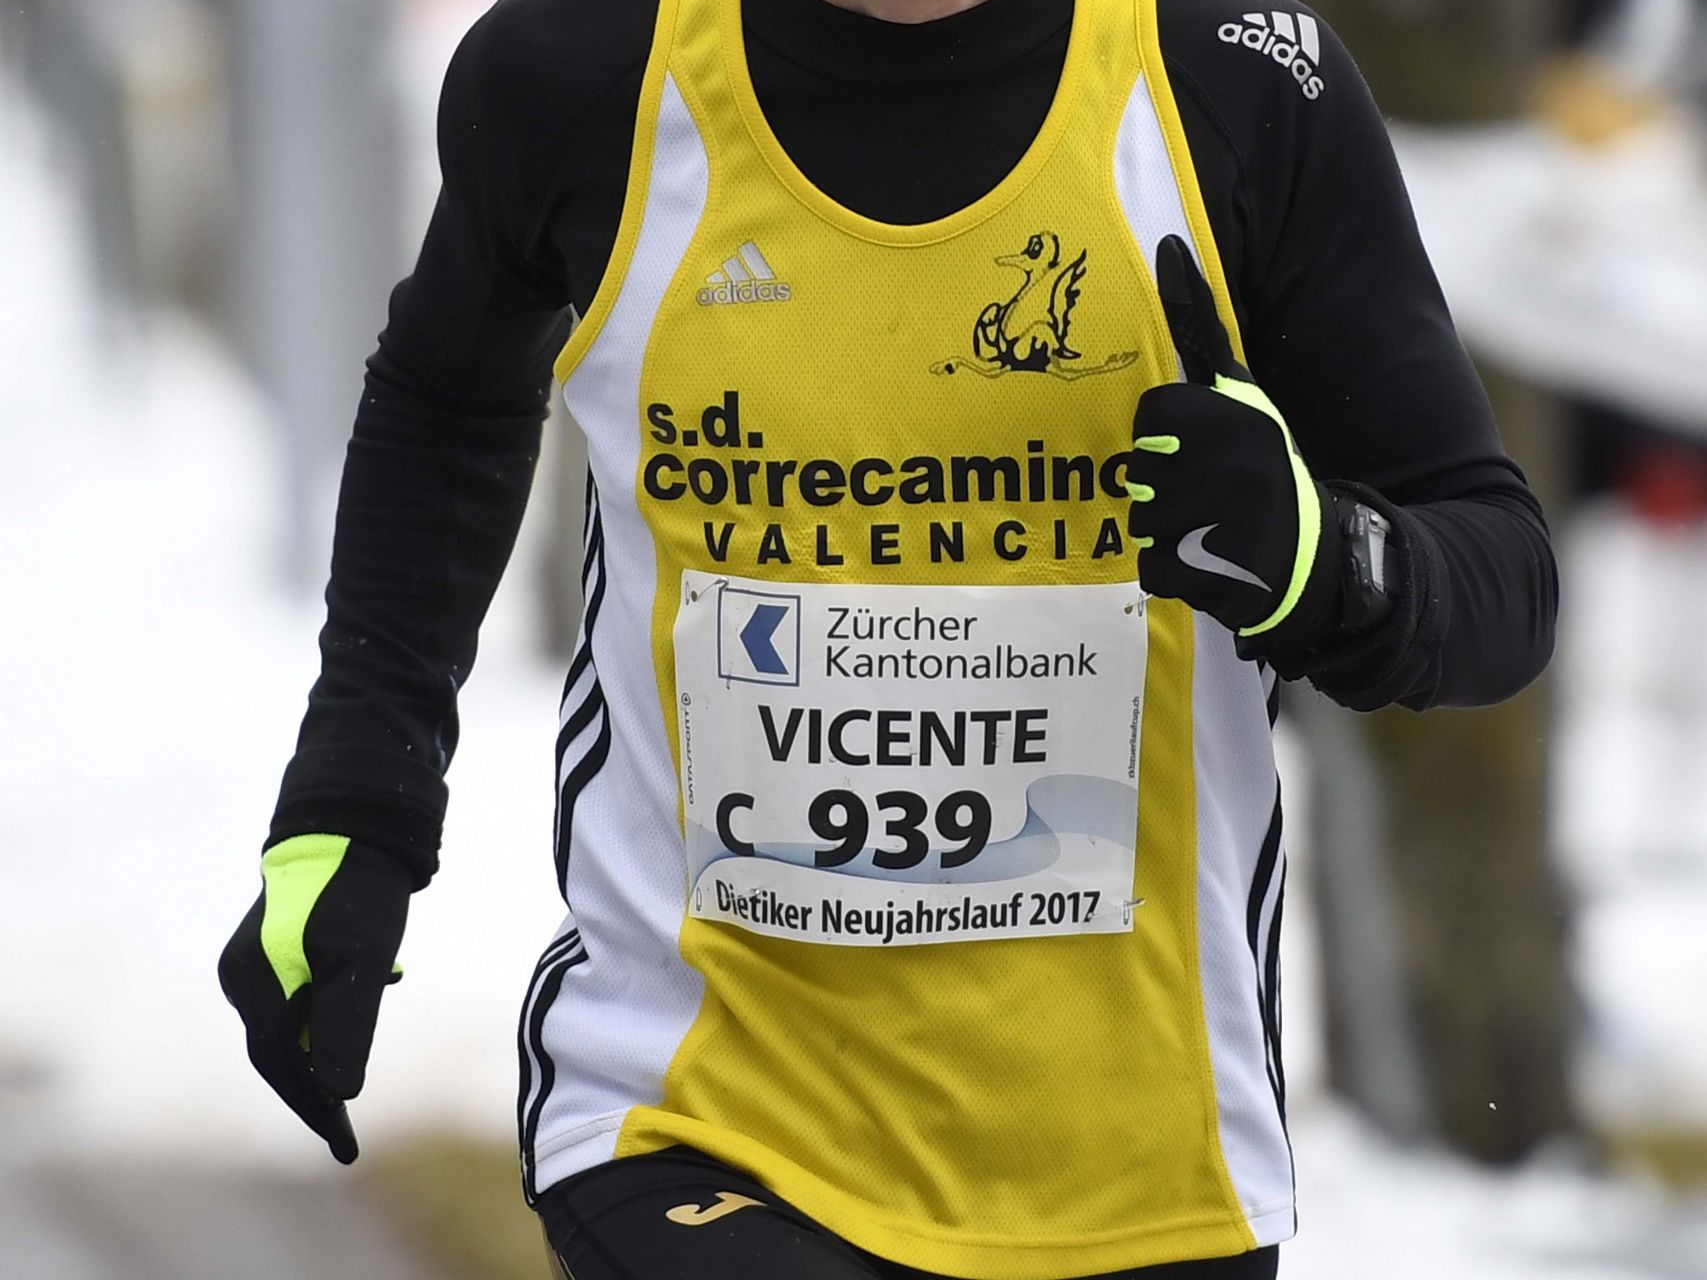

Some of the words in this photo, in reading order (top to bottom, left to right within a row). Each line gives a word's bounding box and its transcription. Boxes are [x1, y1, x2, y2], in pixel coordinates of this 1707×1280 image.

[1217, 23, 1324, 100] adidas
[696, 280, 791, 306] adidas
[647, 391, 763, 448] s.d.
[704, 517, 1124, 566] VALENCIA
[827, 607, 977, 641] Zürcher
[826, 644, 1098, 679] Kantonalbank
[684, 707, 694, 805] DATASPORT
[757, 704, 1048, 766] VICENTE
[716, 792, 755, 857] C
[808, 789, 992, 870] 939
[715, 879, 812, 932] Dietiker
[822, 891, 1023, 944] Neujahrslauf
[1029, 891, 1101, 926] 2017
